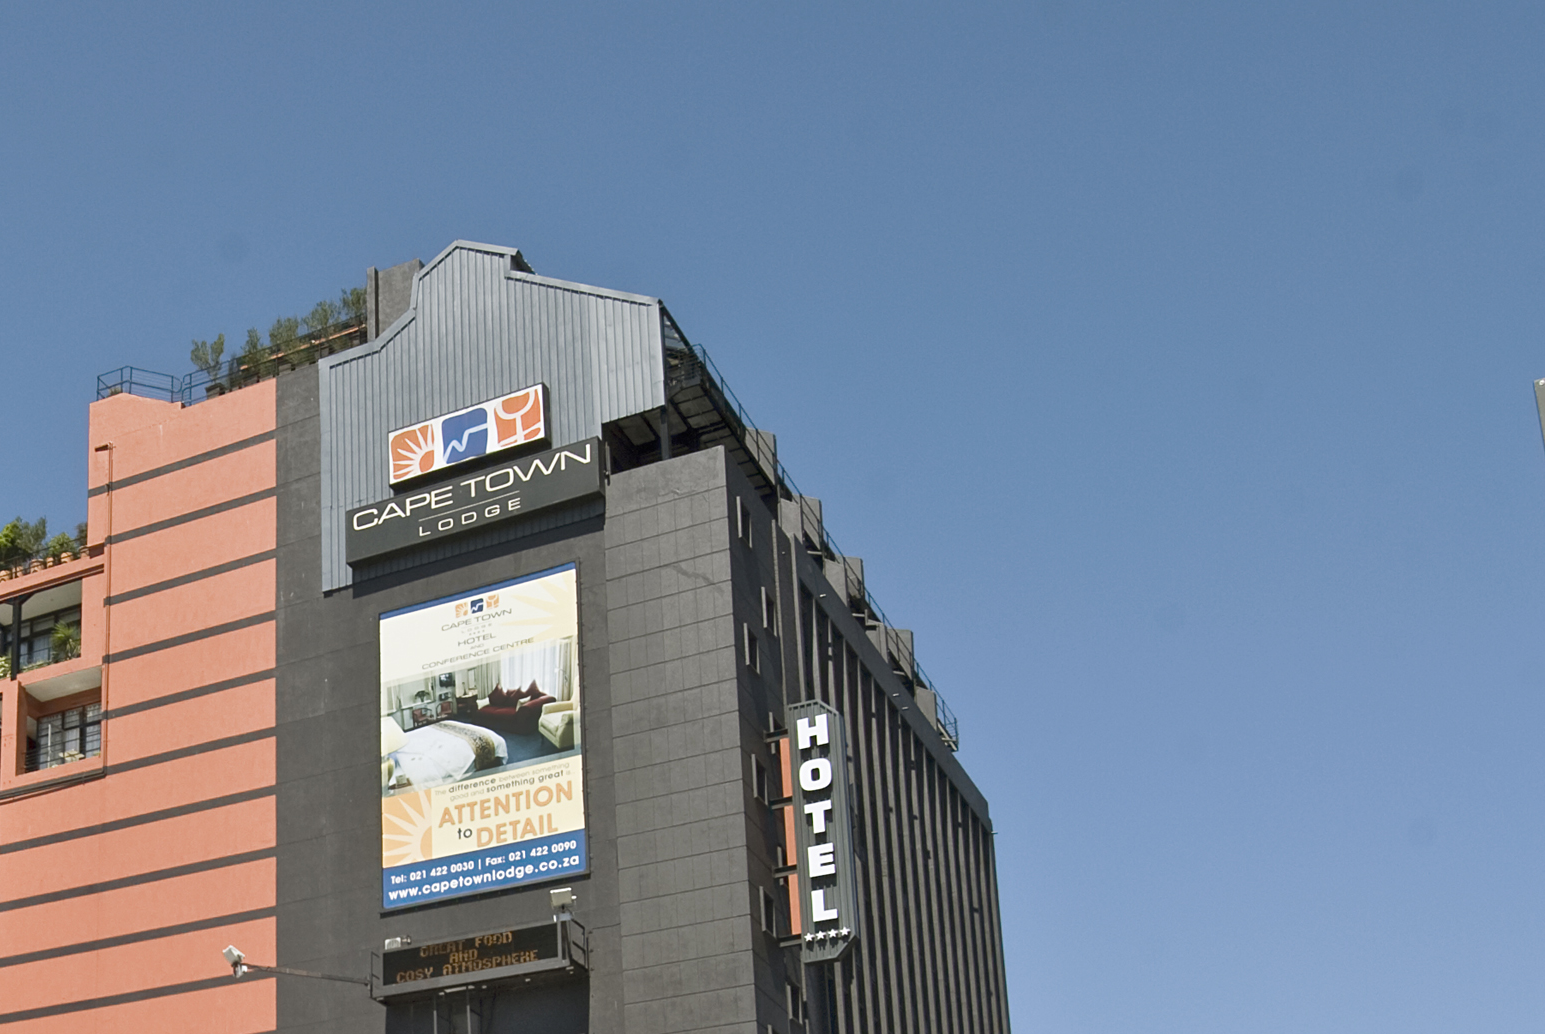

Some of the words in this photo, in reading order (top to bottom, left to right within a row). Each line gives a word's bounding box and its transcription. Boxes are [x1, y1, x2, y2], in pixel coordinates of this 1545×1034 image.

[352, 485, 453, 531] CAPE
[460, 443, 592, 498] TOWN
[419, 498, 521, 537] LODGE
[441, 618, 472, 632] CAPE
[473, 608, 512, 623] TOWN
[421, 648, 490, 670] CONFERENCE
[492, 637, 535, 653] CENTRE
[457, 632, 497, 647] HOTEL
[448, 777, 497, 794] difference
[531, 761, 570, 776] something
[449, 792, 469, 802] good
[486, 777, 535, 794] something
[537, 769, 564, 783] great
[438, 780, 573, 828] ATTENTION
[796, 713, 839, 923] HOTEL
[457, 827, 473, 840] to
[476, 813, 558, 848] DETAIL
[388, 854, 580, 901] www.capetownlodge.co.za
[390, 874, 407, 885] Tel:
[409, 869, 427, 882] 021
[430, 866, 448, 877] 422
[450, 860, 475, 874] 0030
[485, 856, 506, 867] Fax:
[508, 850, 526, 862] 021
[529, 845, 549, 857] 422
[551, 839, 577, 854] 0090
[474, 931, 513, 948] FOOD
[449, 949, 478, 964] AND
[396, 966, 434, 983] COSY
